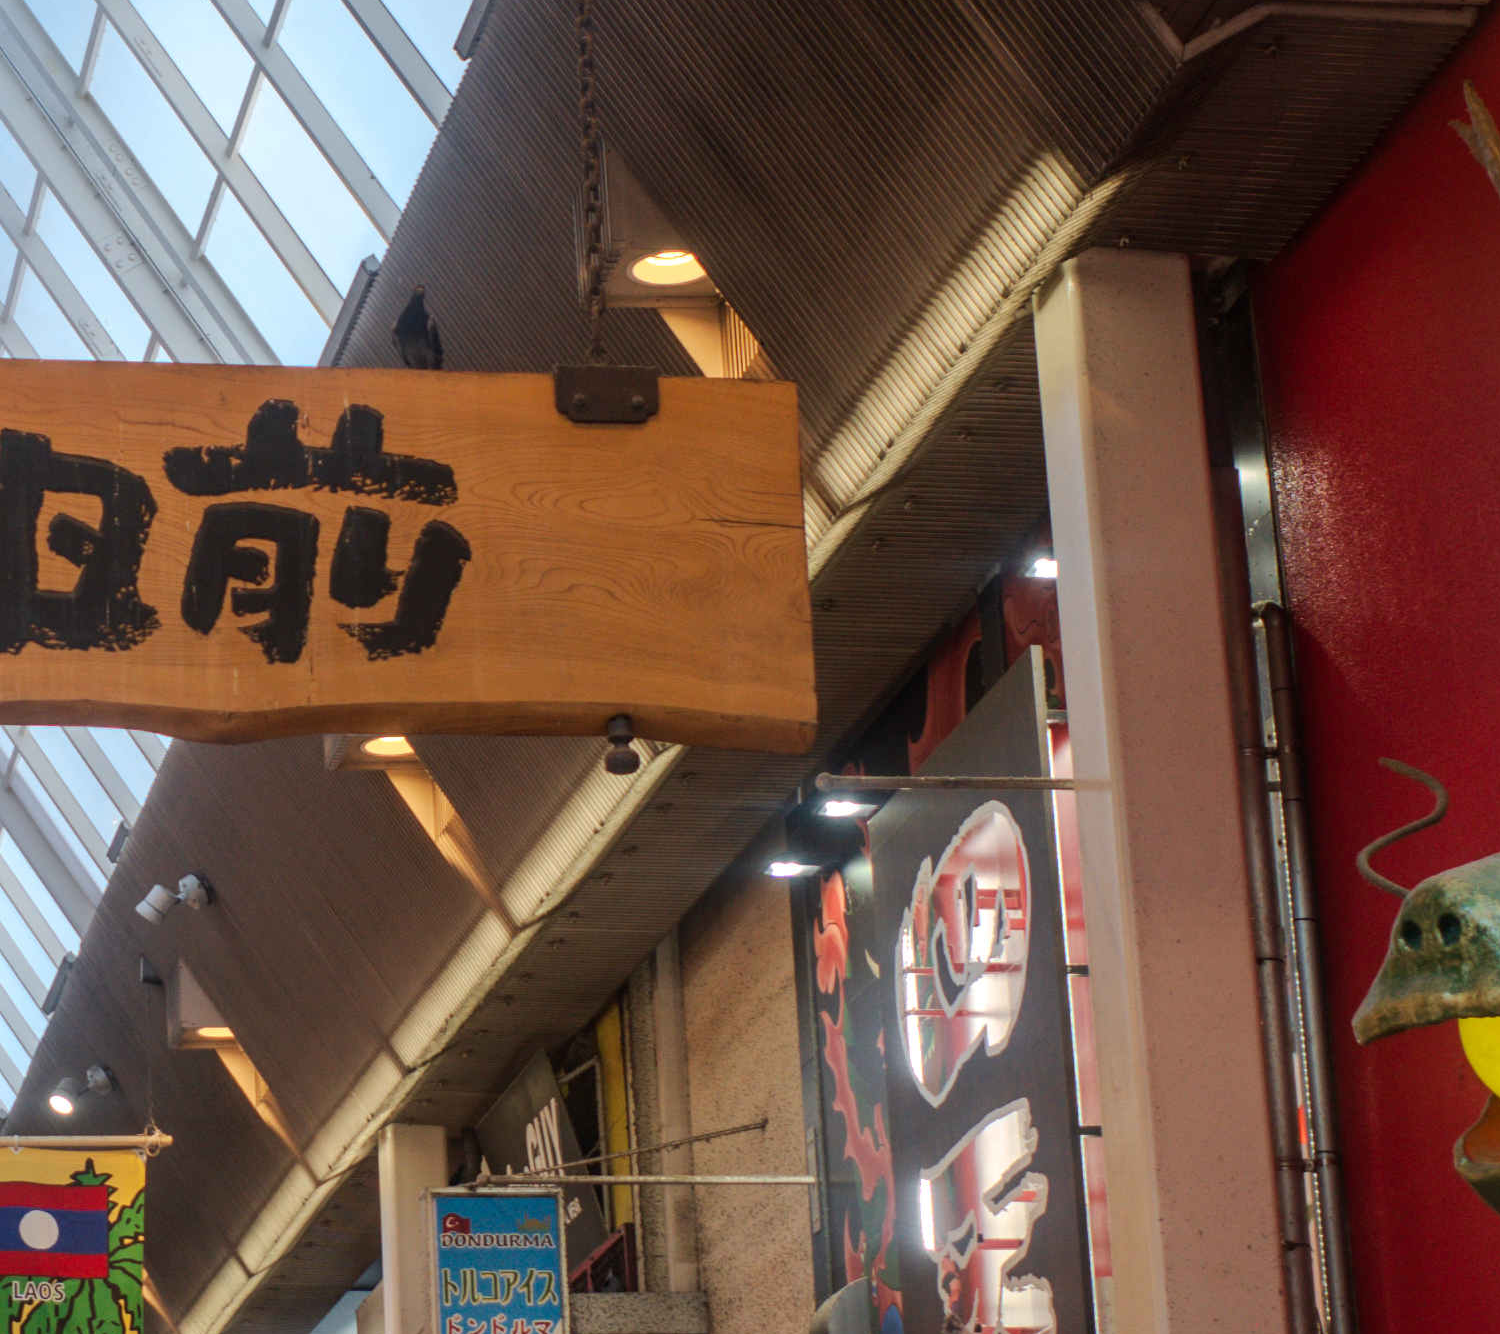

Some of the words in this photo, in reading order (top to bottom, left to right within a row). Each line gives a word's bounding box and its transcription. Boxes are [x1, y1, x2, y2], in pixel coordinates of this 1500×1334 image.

[441, 1233, 556, 1249] DONDURMA
[12, 1280, 66, 1304] LAOS
[442, 1268, 560, 1307] トルコアイス
